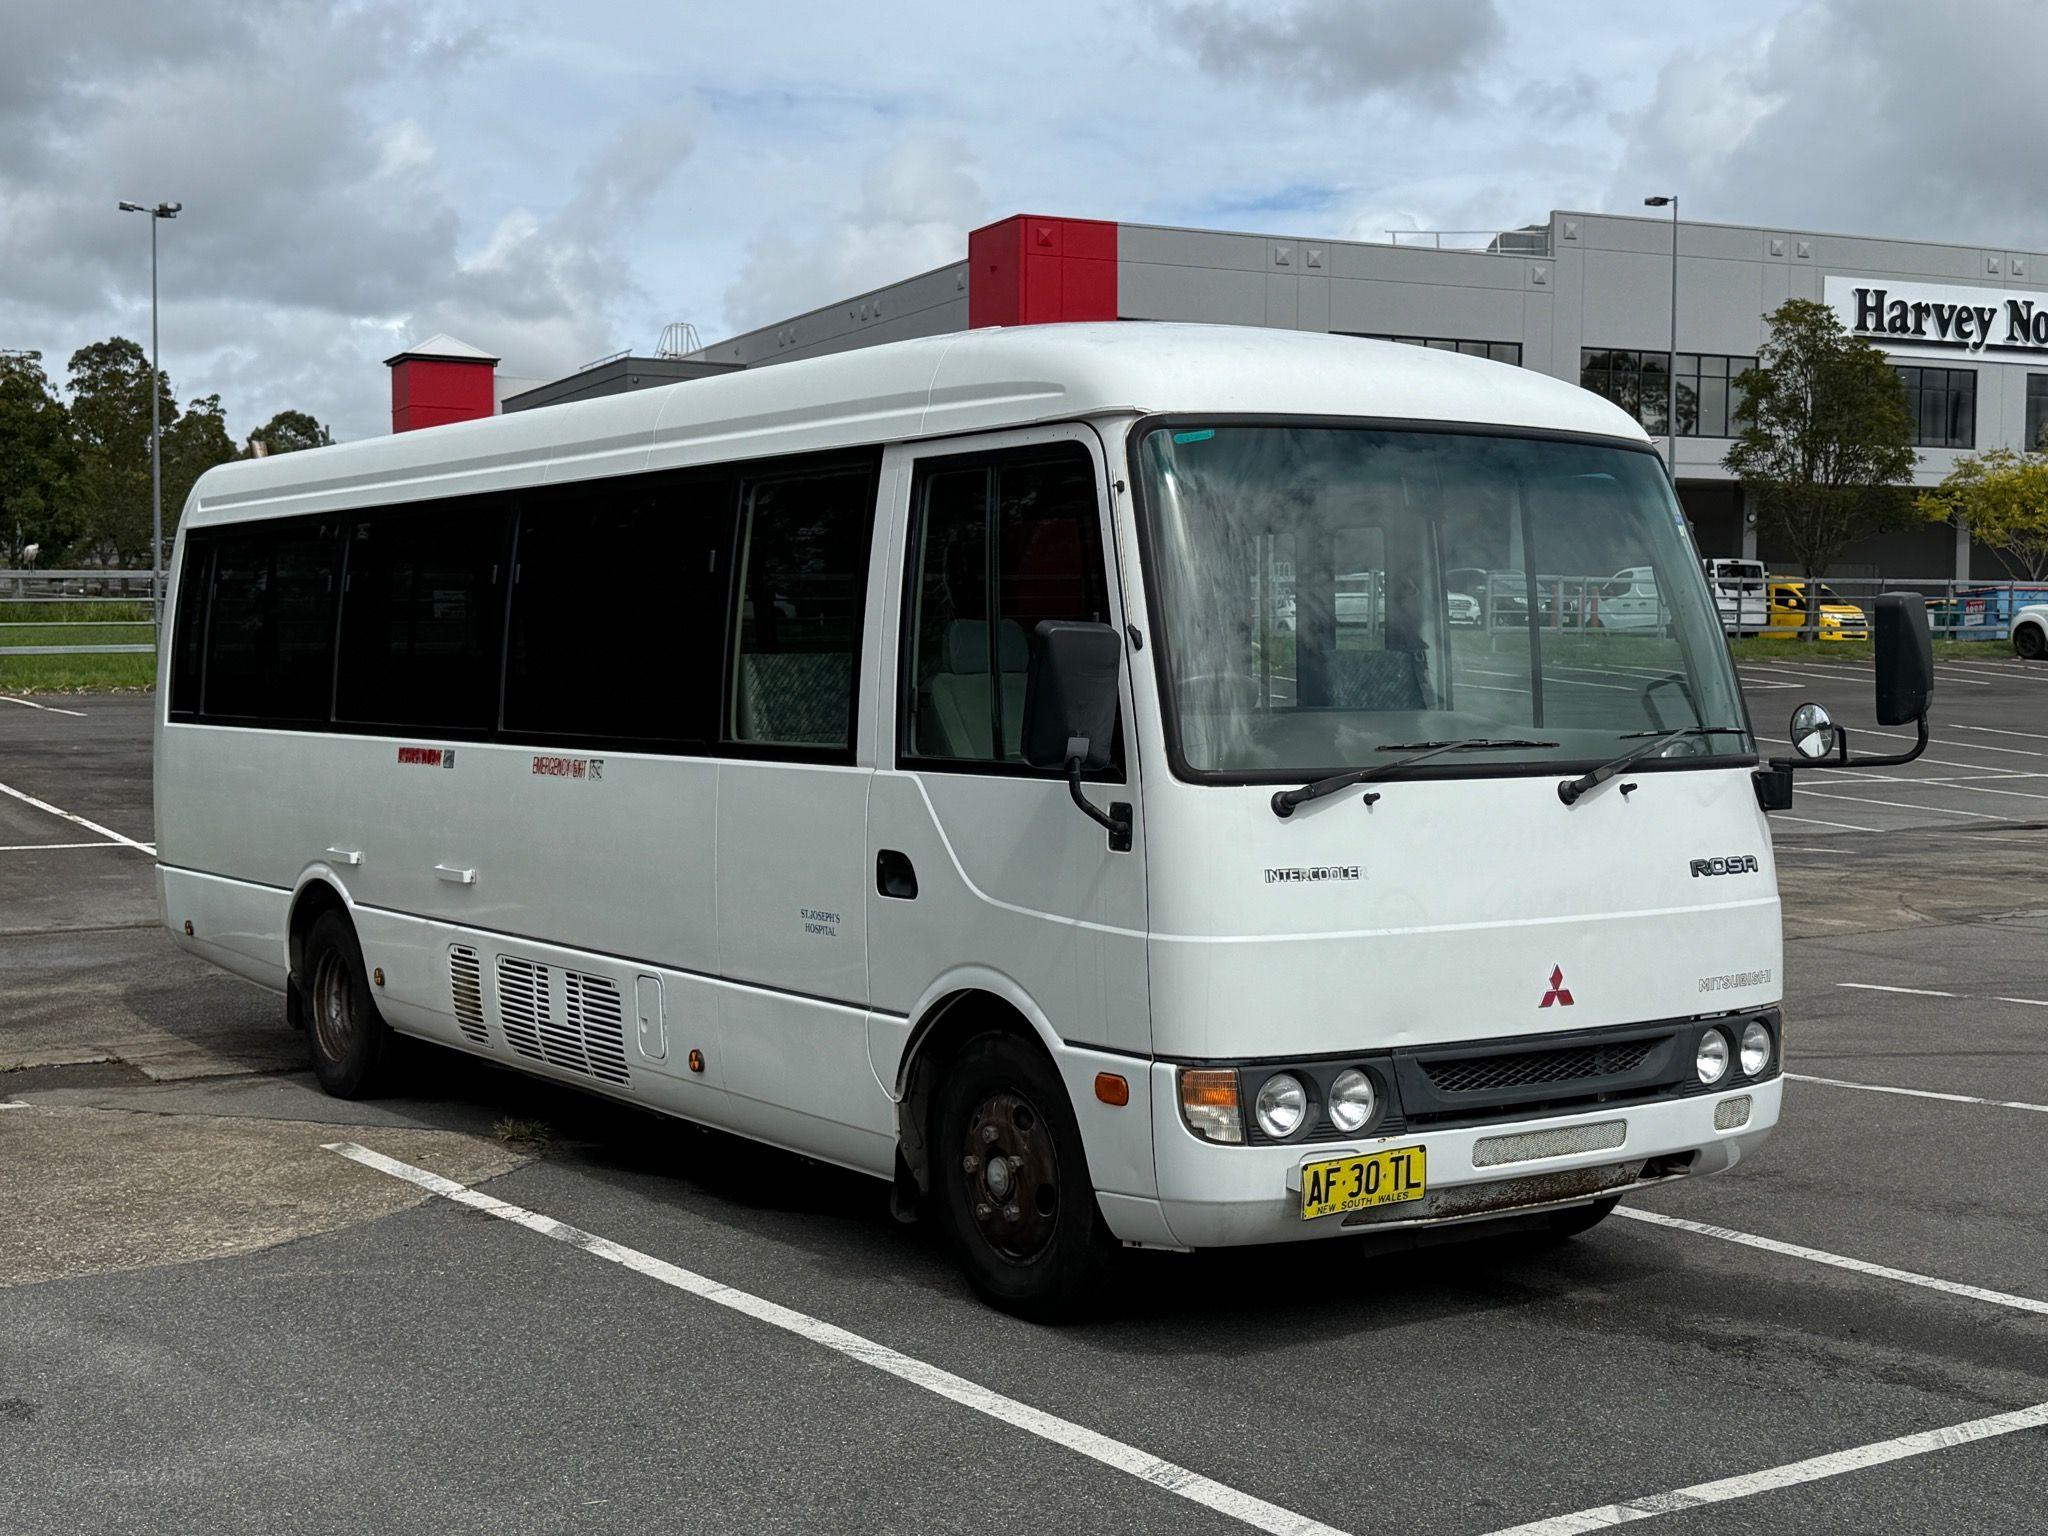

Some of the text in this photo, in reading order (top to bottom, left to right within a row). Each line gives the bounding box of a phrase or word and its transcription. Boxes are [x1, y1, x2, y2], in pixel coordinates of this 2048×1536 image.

[1854, 288, 1997, 350] Harvey
[1690, 855, 1758, 878] ROSA
[805, 922, 836, 937] HOSPITAL
[1698, 969, 1772, 993] MITSUBISHI
[1316, 1191, 1409, 1215] NEW SOUTH WALES
